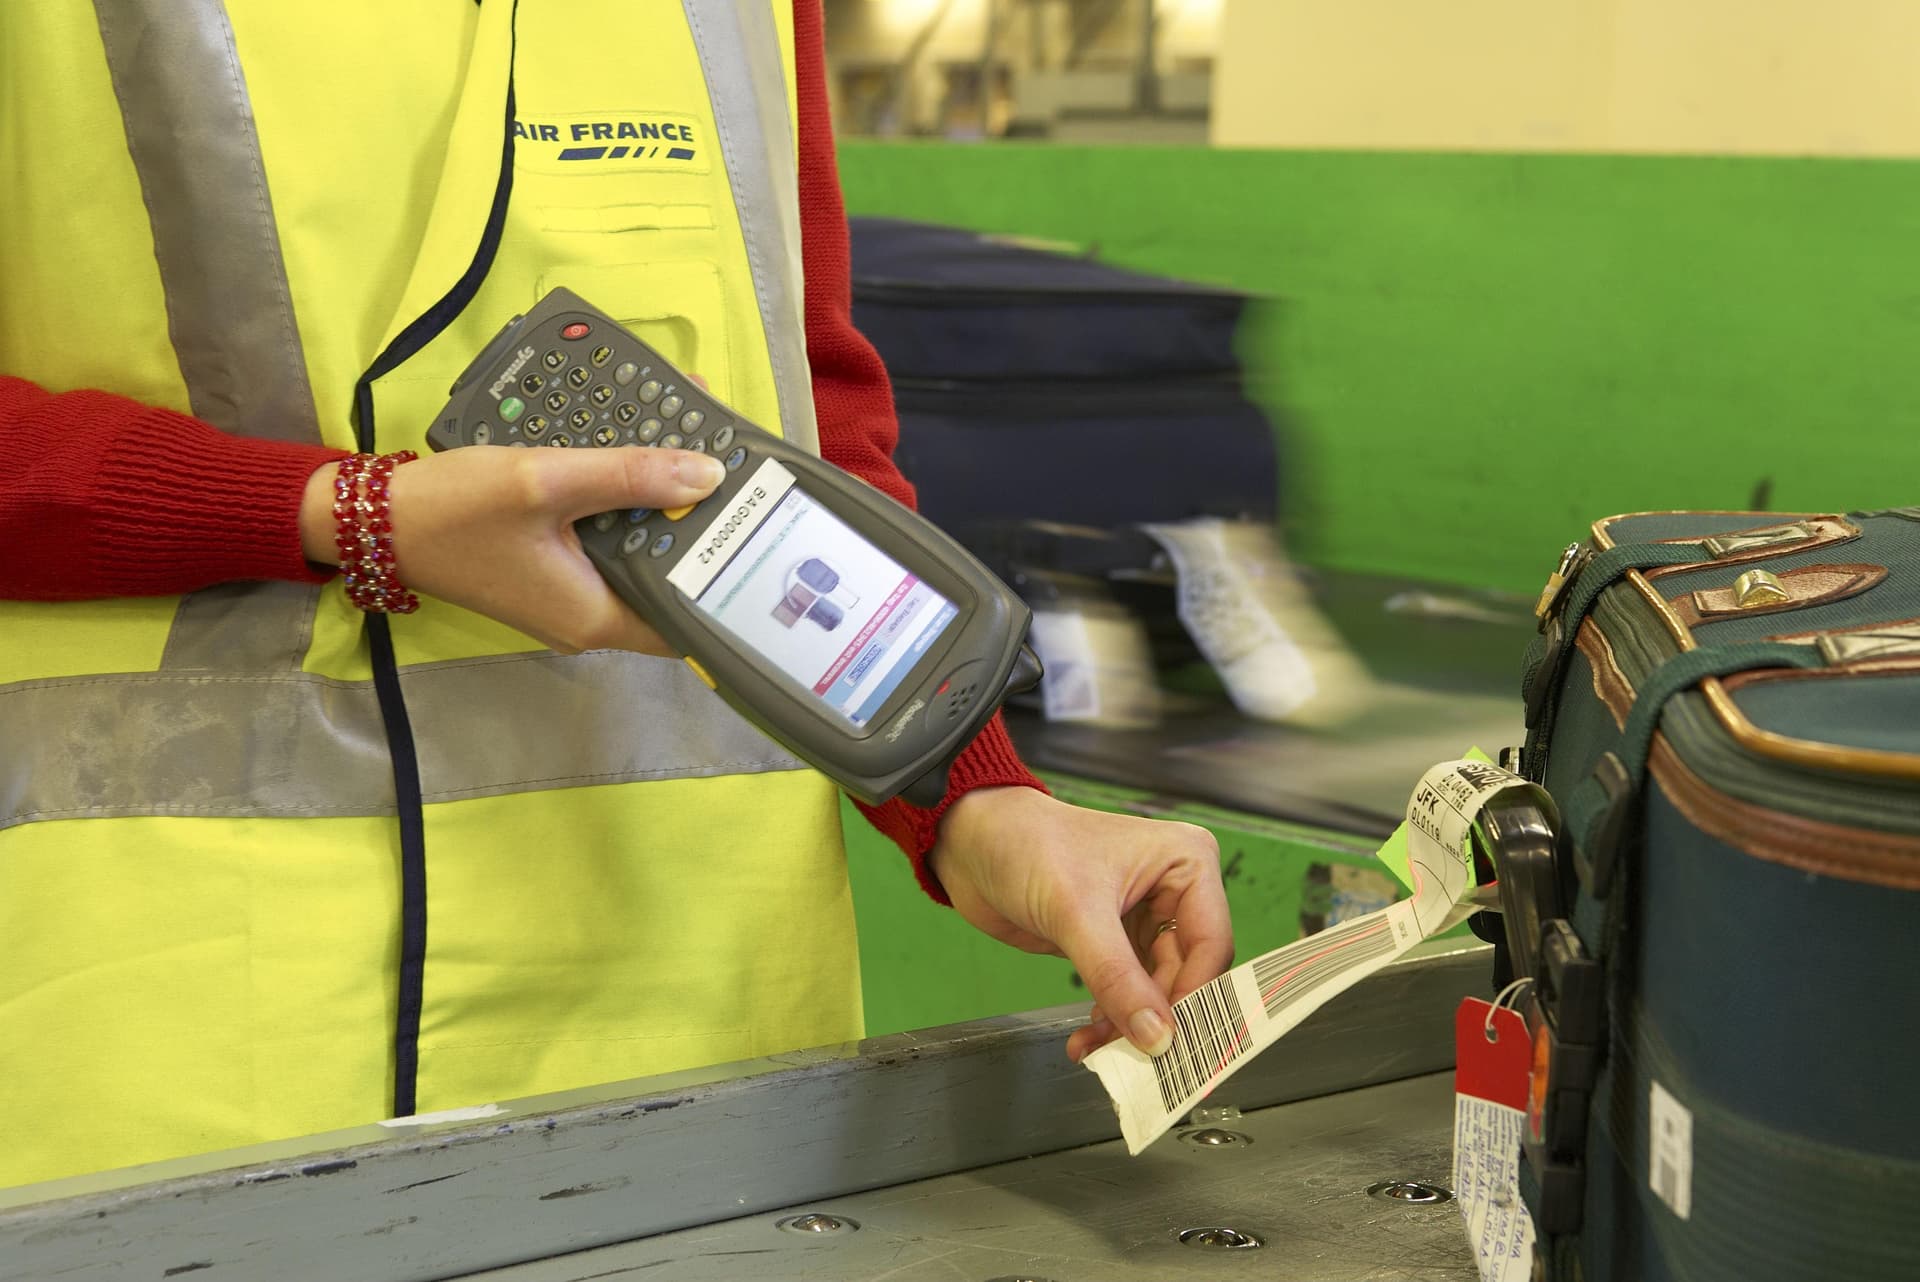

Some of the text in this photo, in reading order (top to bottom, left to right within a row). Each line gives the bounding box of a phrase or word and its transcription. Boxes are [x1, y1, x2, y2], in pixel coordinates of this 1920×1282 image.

[513, 120, 694, 142] AIR FRANCE
[488, 346, 535, 400] symbol
[699, 486, 766, 564] BAG000042
[1416, 788, 1440, 816] JFK
